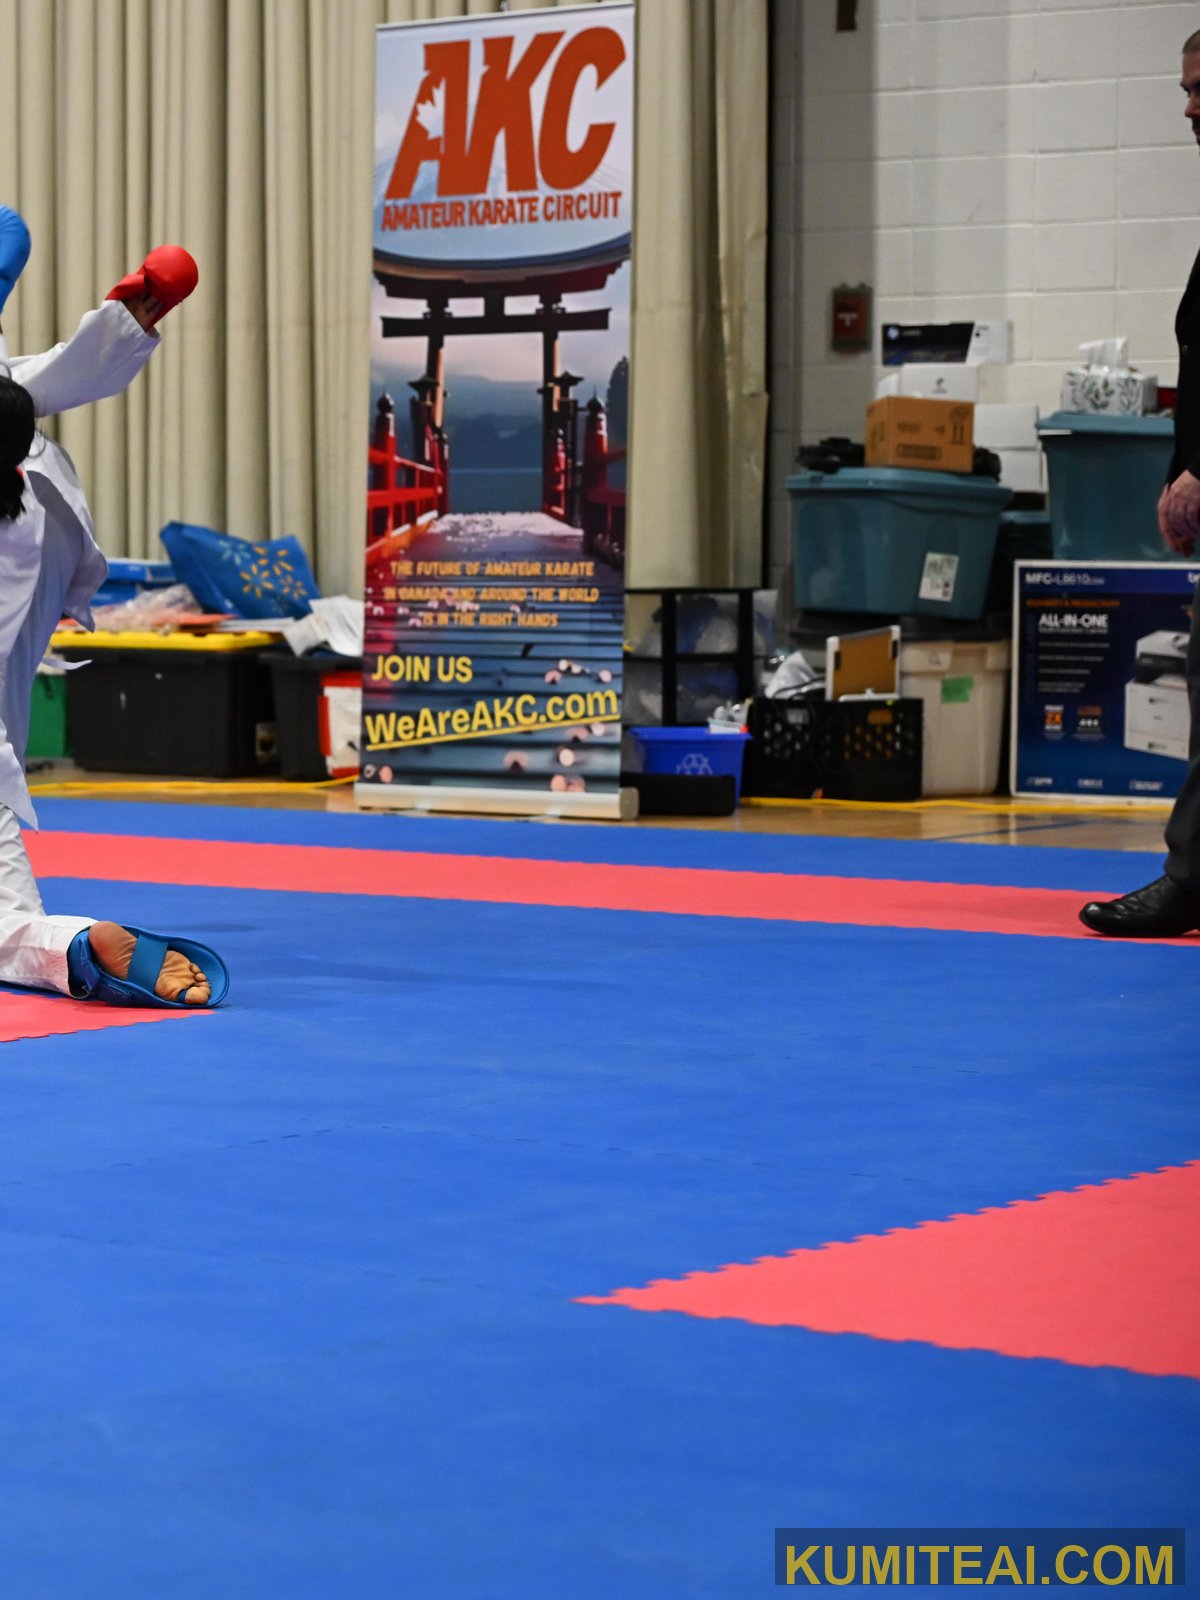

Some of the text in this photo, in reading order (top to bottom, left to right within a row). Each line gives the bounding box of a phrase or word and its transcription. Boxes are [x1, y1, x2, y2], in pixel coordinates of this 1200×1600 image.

[385, 26, 626, 200] AKC
[381, 191, 622, 231] AMATEUR KARATE CIRCUIT
[390, 561, 595, 577] THE FUTURE OF AMATEUR KARATE
[383, 587, 599, 602] IN CANADA AND AROUND THE WORLD
[423, 613, 558, 627] IS IN THE RIGHT HANDS
[1038, 614, 1108, 628] ALL-IN-ONE
[372, 655, 473, 682] JOIN US
[365, 689, 619, 745] WeAreAKC.com
